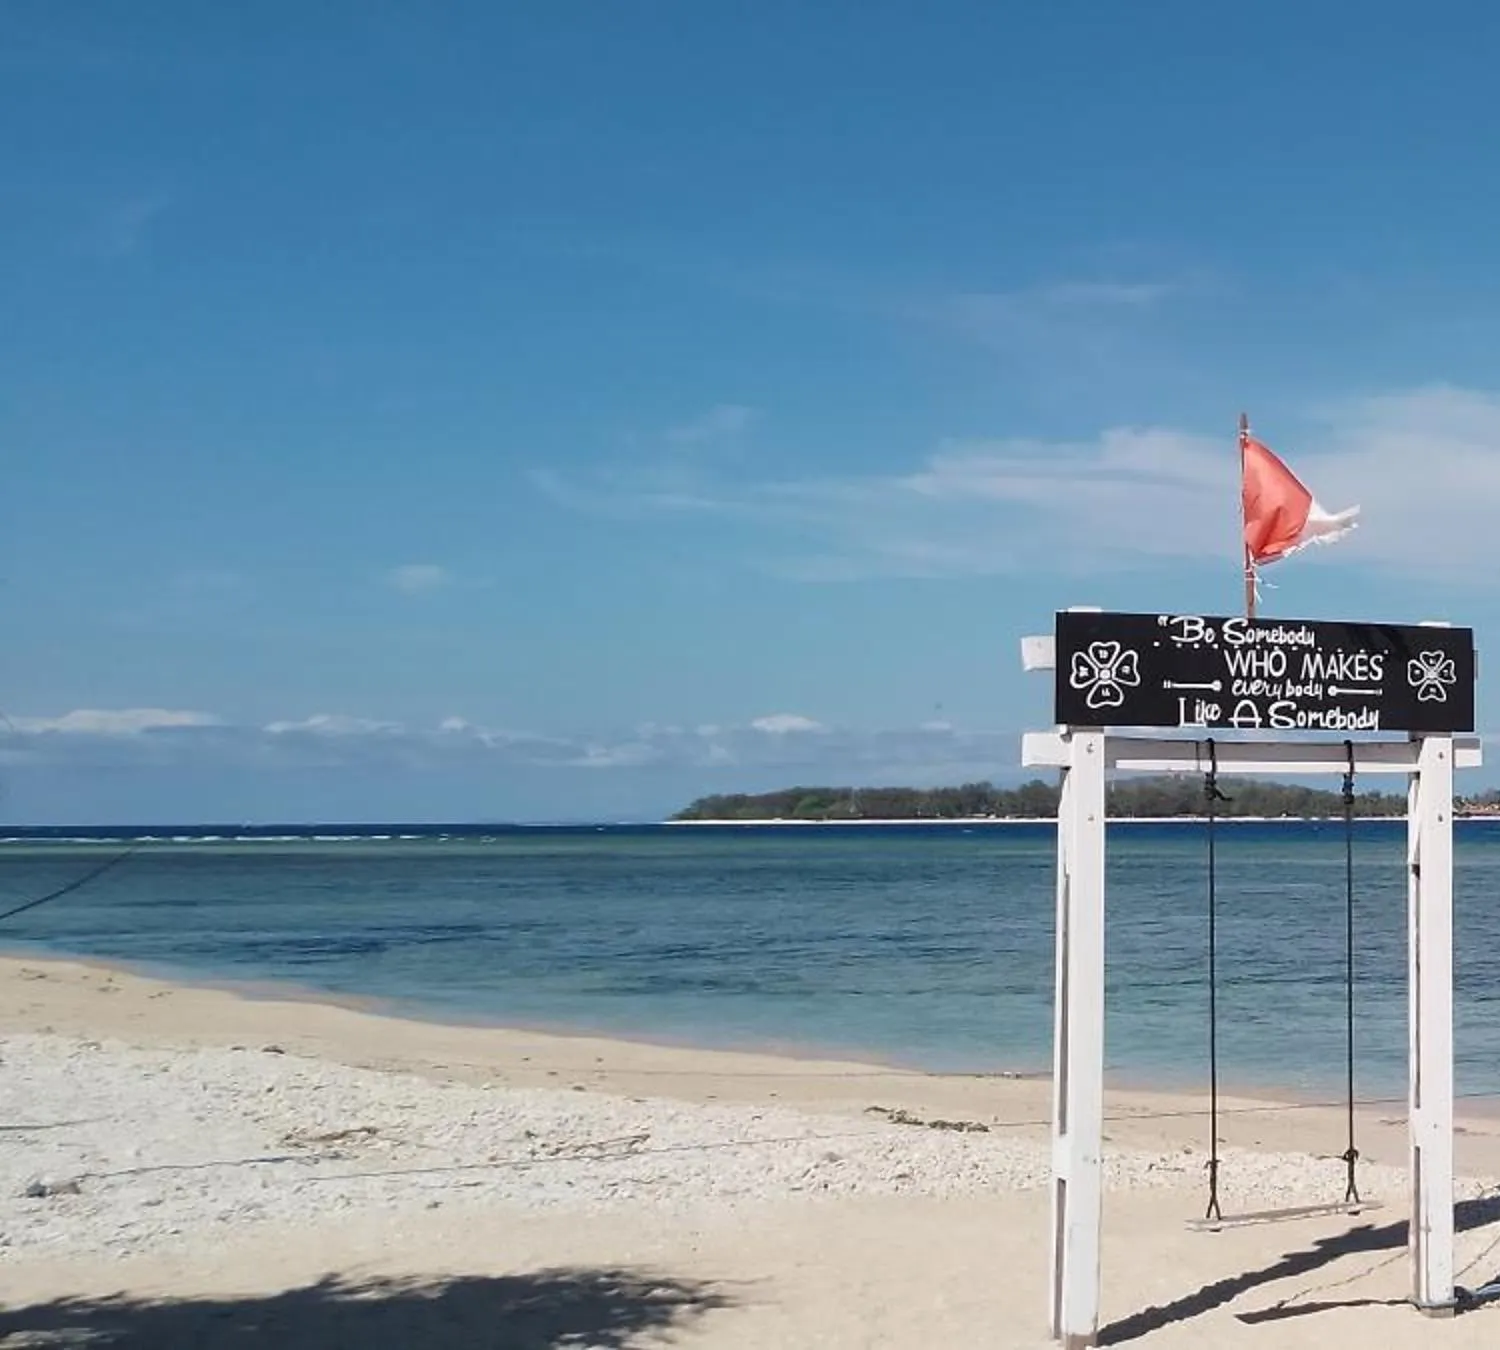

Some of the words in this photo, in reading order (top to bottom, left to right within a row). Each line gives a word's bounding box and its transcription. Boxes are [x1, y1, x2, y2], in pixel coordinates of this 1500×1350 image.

[1222, 617, 1315, 648] Somebody
[1223, 649, 1287, 677] WHO
[1300, 652, 1384, 681] MAKES
[1228, 699, 1263, 728] A
[1268, 700, 1380, 731] Somebody
